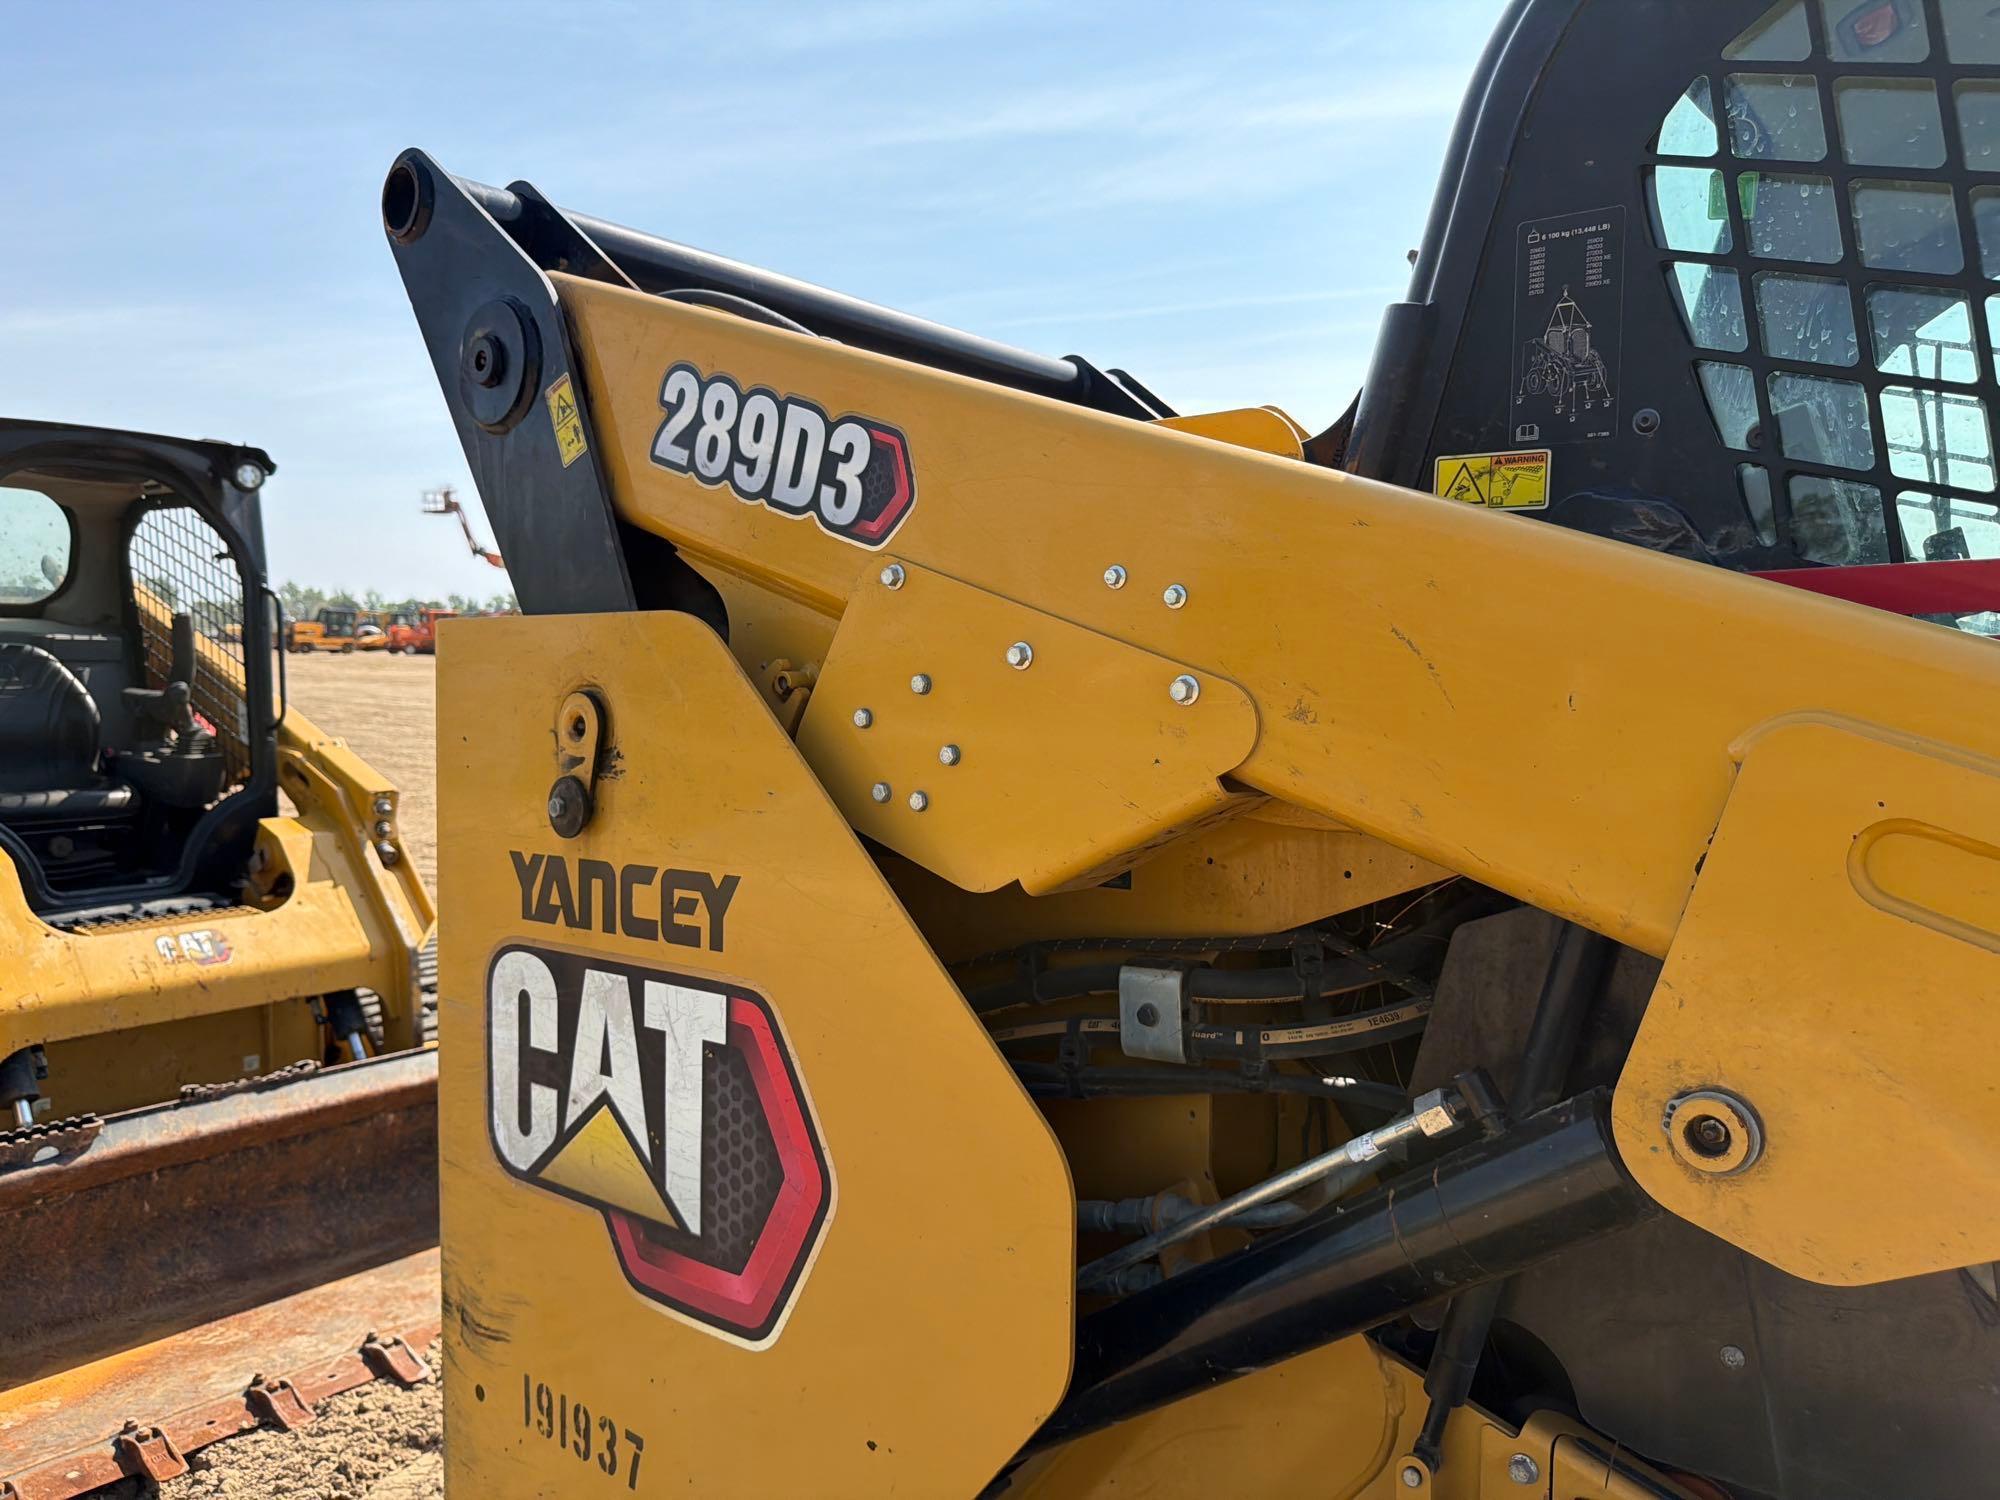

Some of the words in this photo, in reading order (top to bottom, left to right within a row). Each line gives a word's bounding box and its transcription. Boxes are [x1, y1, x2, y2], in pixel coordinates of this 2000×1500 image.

[1598, 223, 1611, 231] LB)
[654, 370, 871, 526] 289D3
[1504, 455, 1545, 464] WARNING
[155, 930, 213, 963] CAT
[509, 850, 741, 952] YANCEY
[491, 950, 727, 1237] CAT
[524, 1373, 644, 1490] 191937
